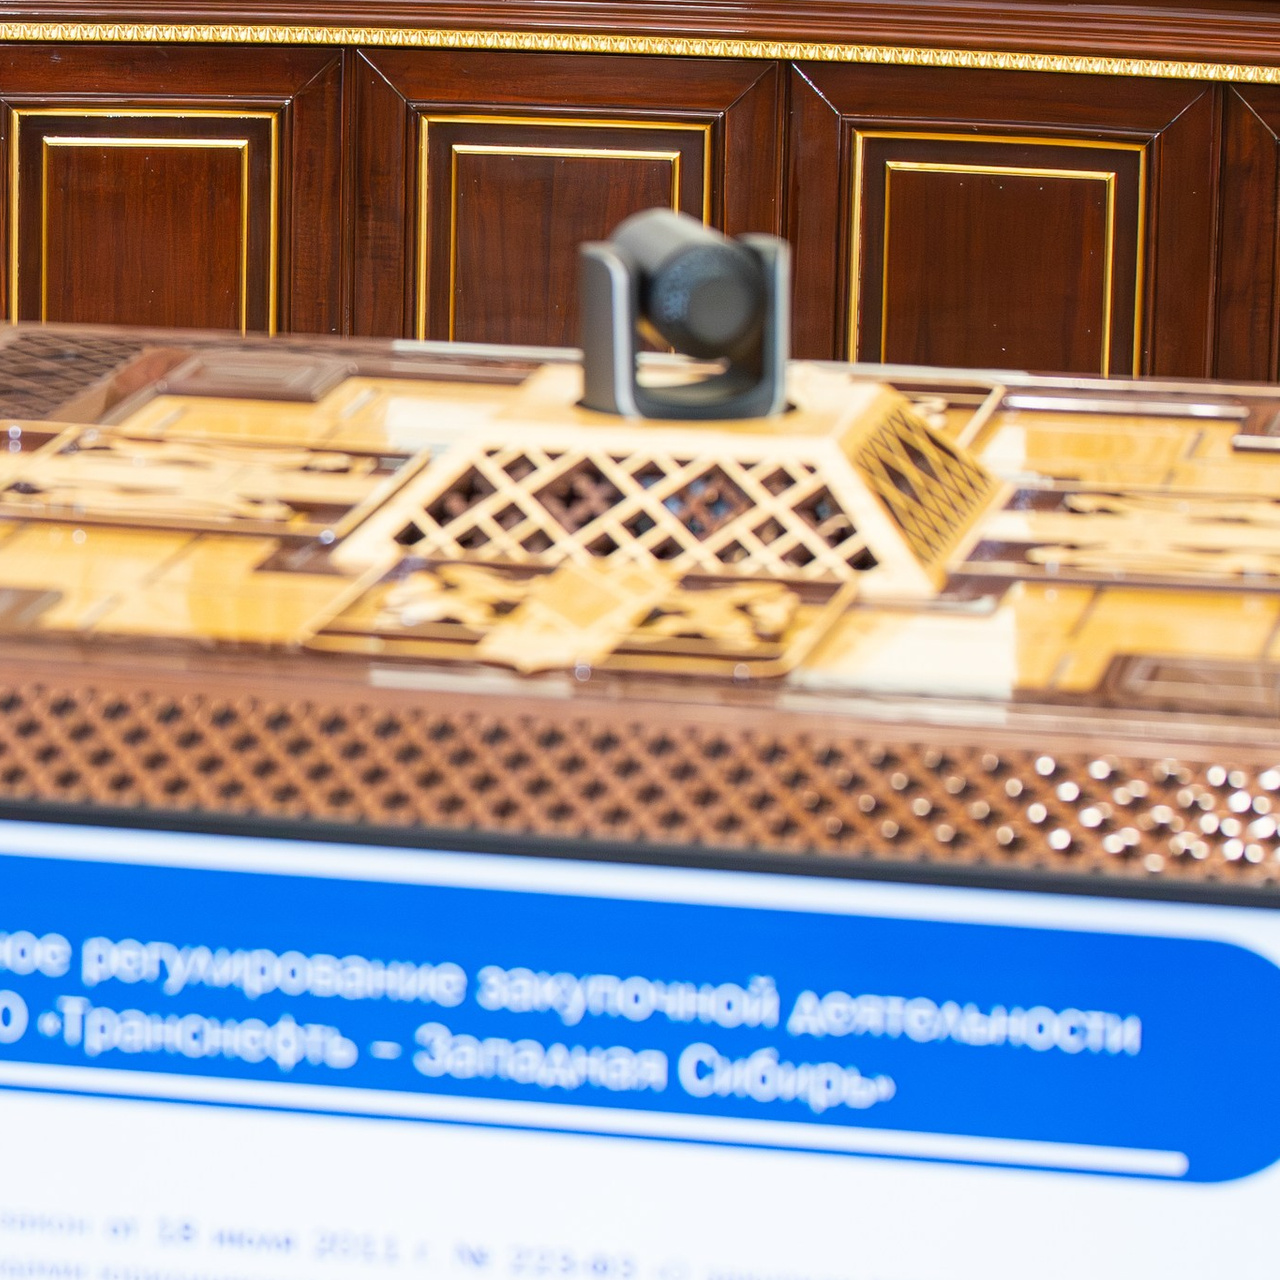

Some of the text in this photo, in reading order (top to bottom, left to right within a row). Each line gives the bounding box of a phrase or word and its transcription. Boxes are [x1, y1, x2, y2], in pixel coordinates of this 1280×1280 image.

[37, 995, 359, 1071] «Транснефть
[413, 1023, 668, 1093] Западная
[81, 937, 468, 1008] регулирование
[476, 964, 781, 1028] закупочной
[788, 990, 1142, 1056] деятельности
